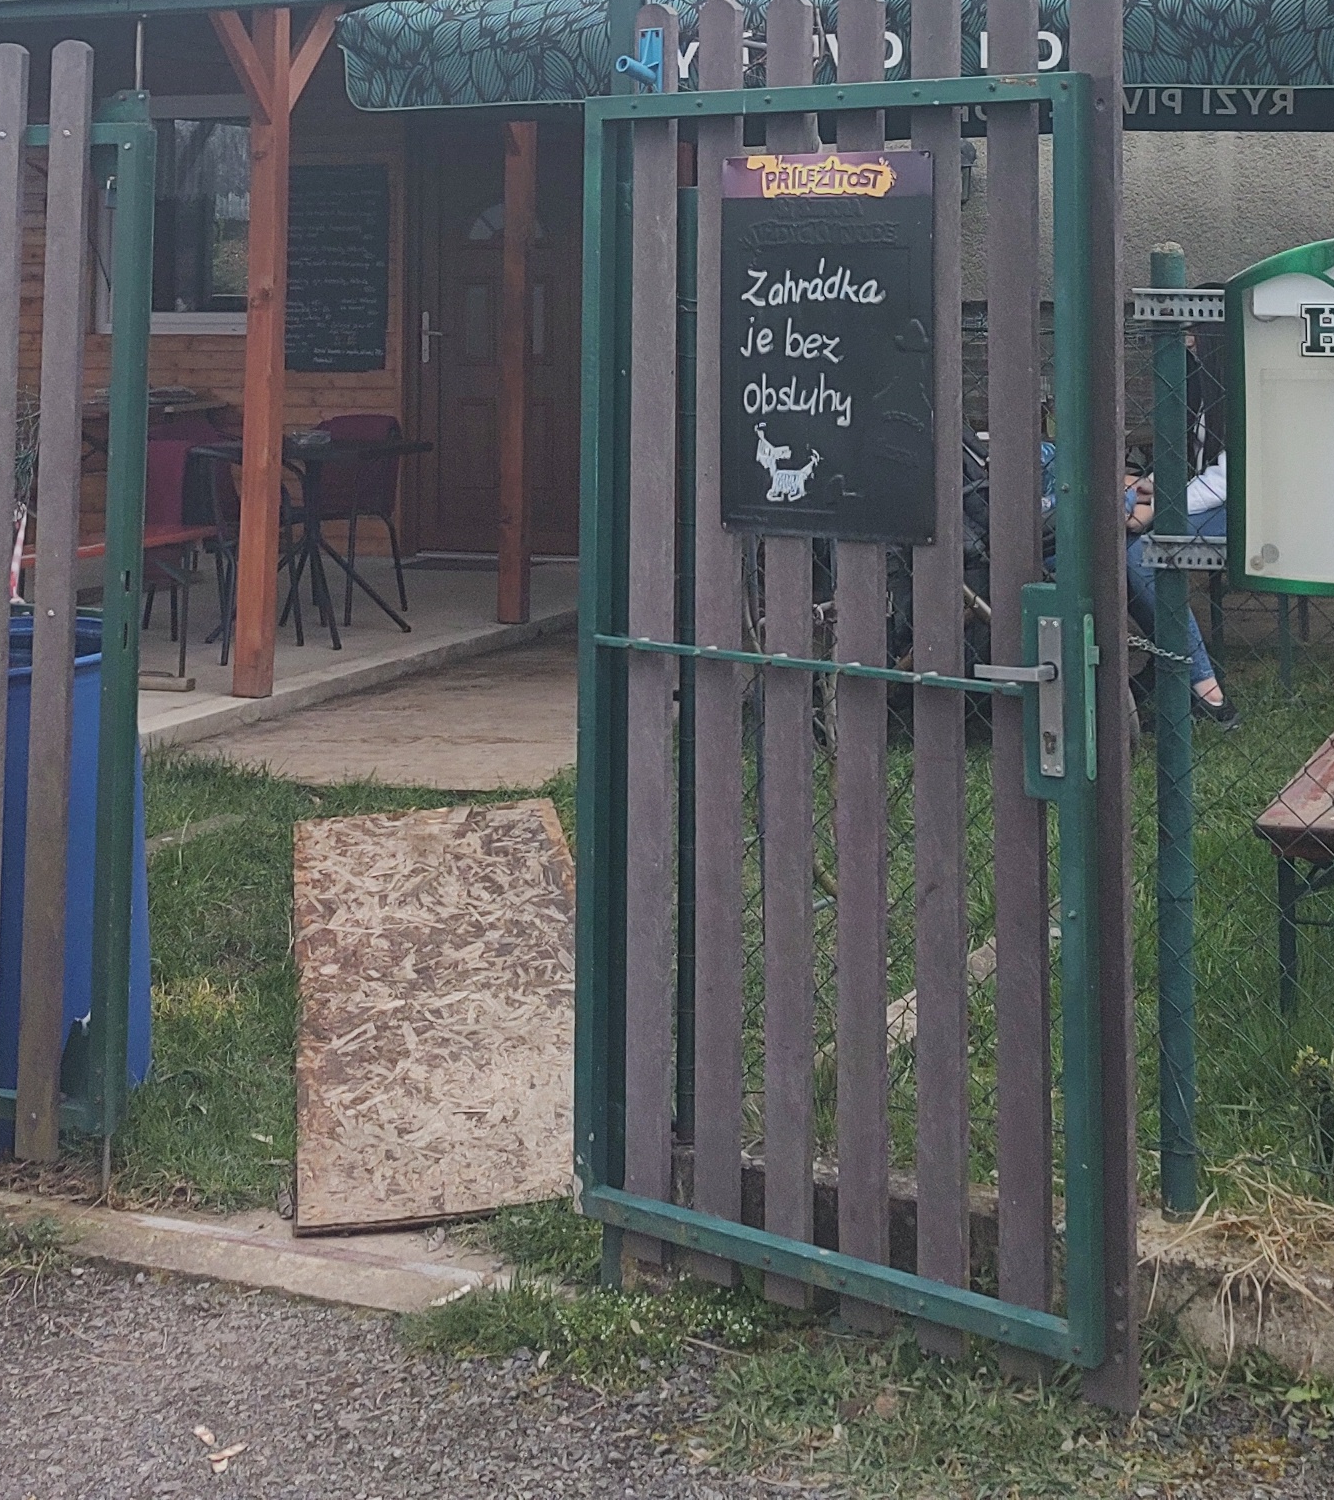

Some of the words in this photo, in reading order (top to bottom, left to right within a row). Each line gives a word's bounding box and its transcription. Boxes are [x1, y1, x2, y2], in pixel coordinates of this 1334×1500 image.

[741, 258, 886, 308] Zahrádka
[740, 317, 774, 358] je
[784, 317, 844, 364] bez
[743, 372, 853, 427] obsluhy
